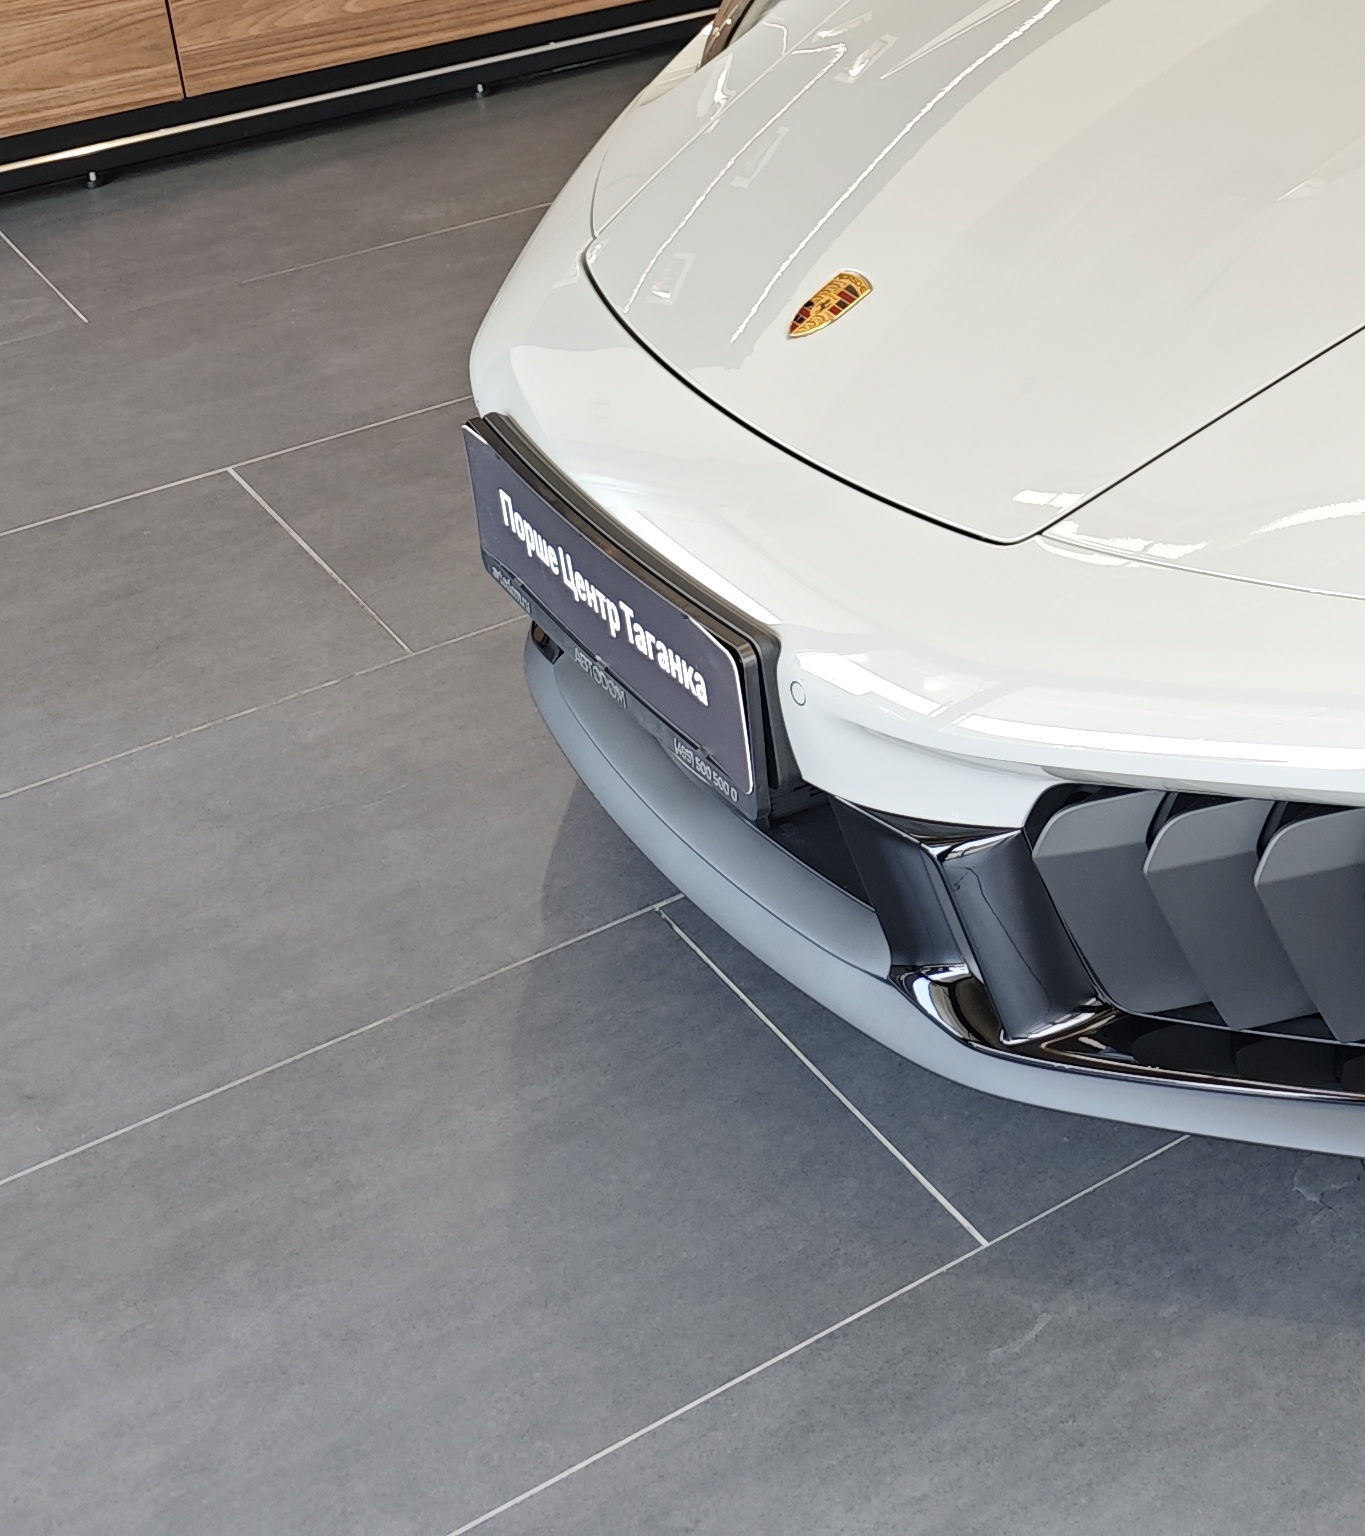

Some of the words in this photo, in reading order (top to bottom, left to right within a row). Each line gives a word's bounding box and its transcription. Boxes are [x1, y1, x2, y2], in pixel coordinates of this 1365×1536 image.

[498, 488, 560, 576] Порше
[557, 546, 621, 639] Центр
[618, 600, 710, 707] Таганка
[695, 756, 712, 781] 500
[712, 770, 730, 796] 500
